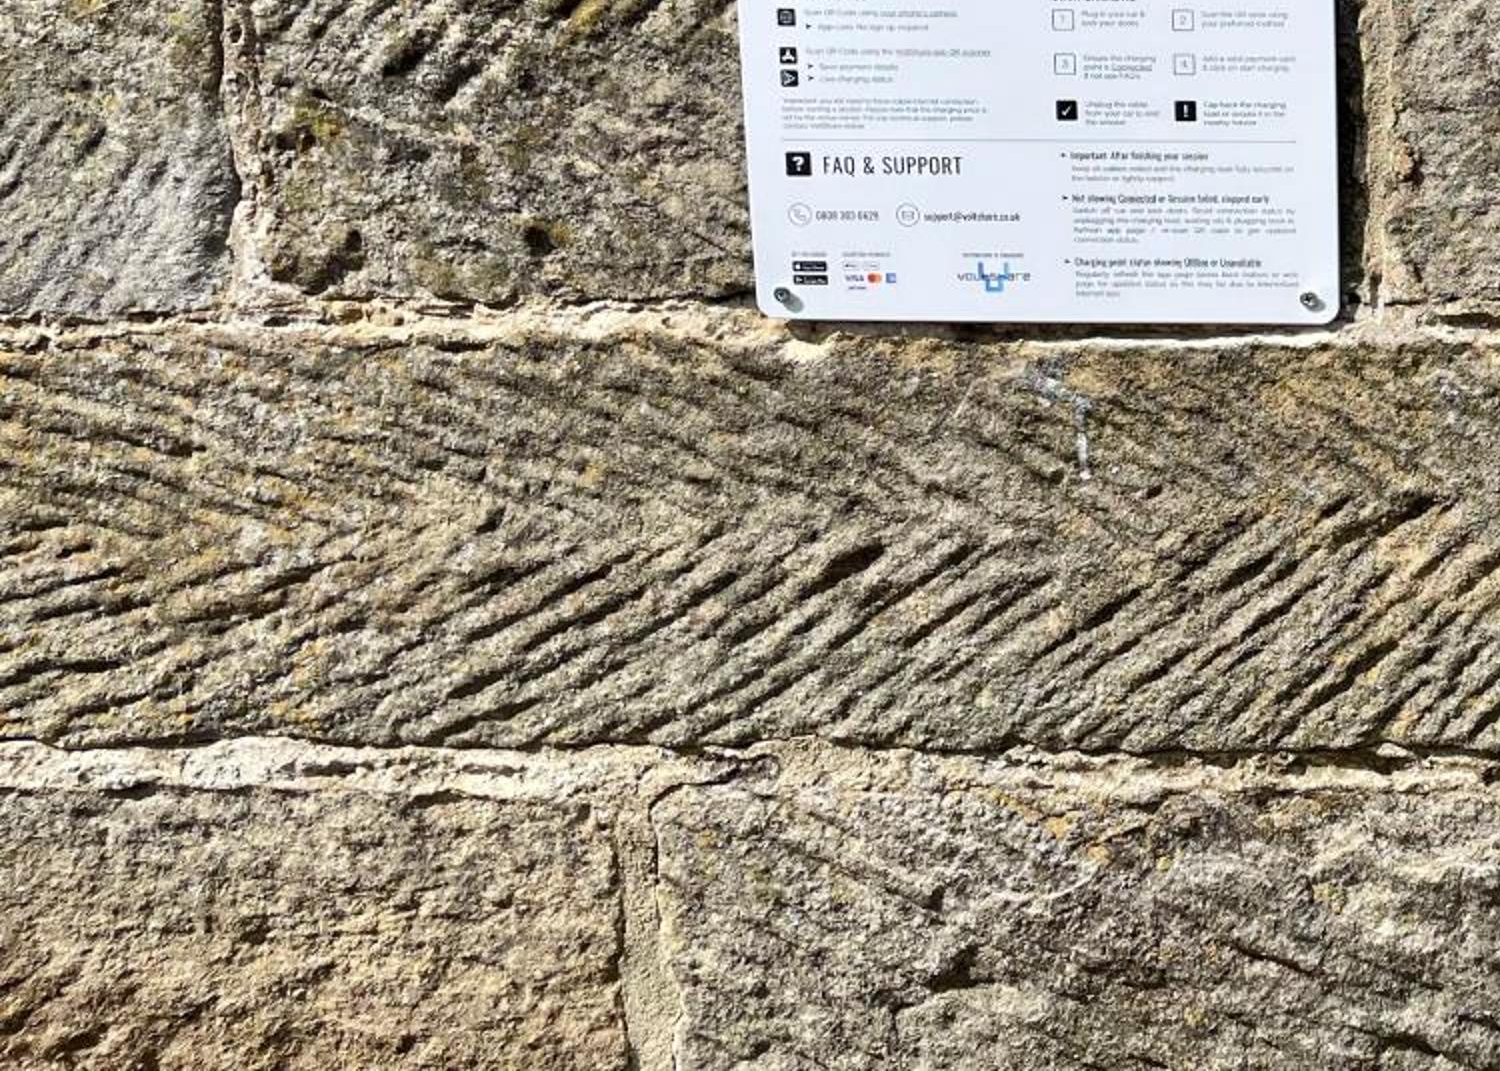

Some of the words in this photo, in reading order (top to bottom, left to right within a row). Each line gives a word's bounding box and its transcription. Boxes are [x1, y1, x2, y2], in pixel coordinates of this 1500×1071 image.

[824, 156, 856, 177] FAQ
[864, 157, 876, 175] &
[884, 156, 963, 176] SUPPORT
